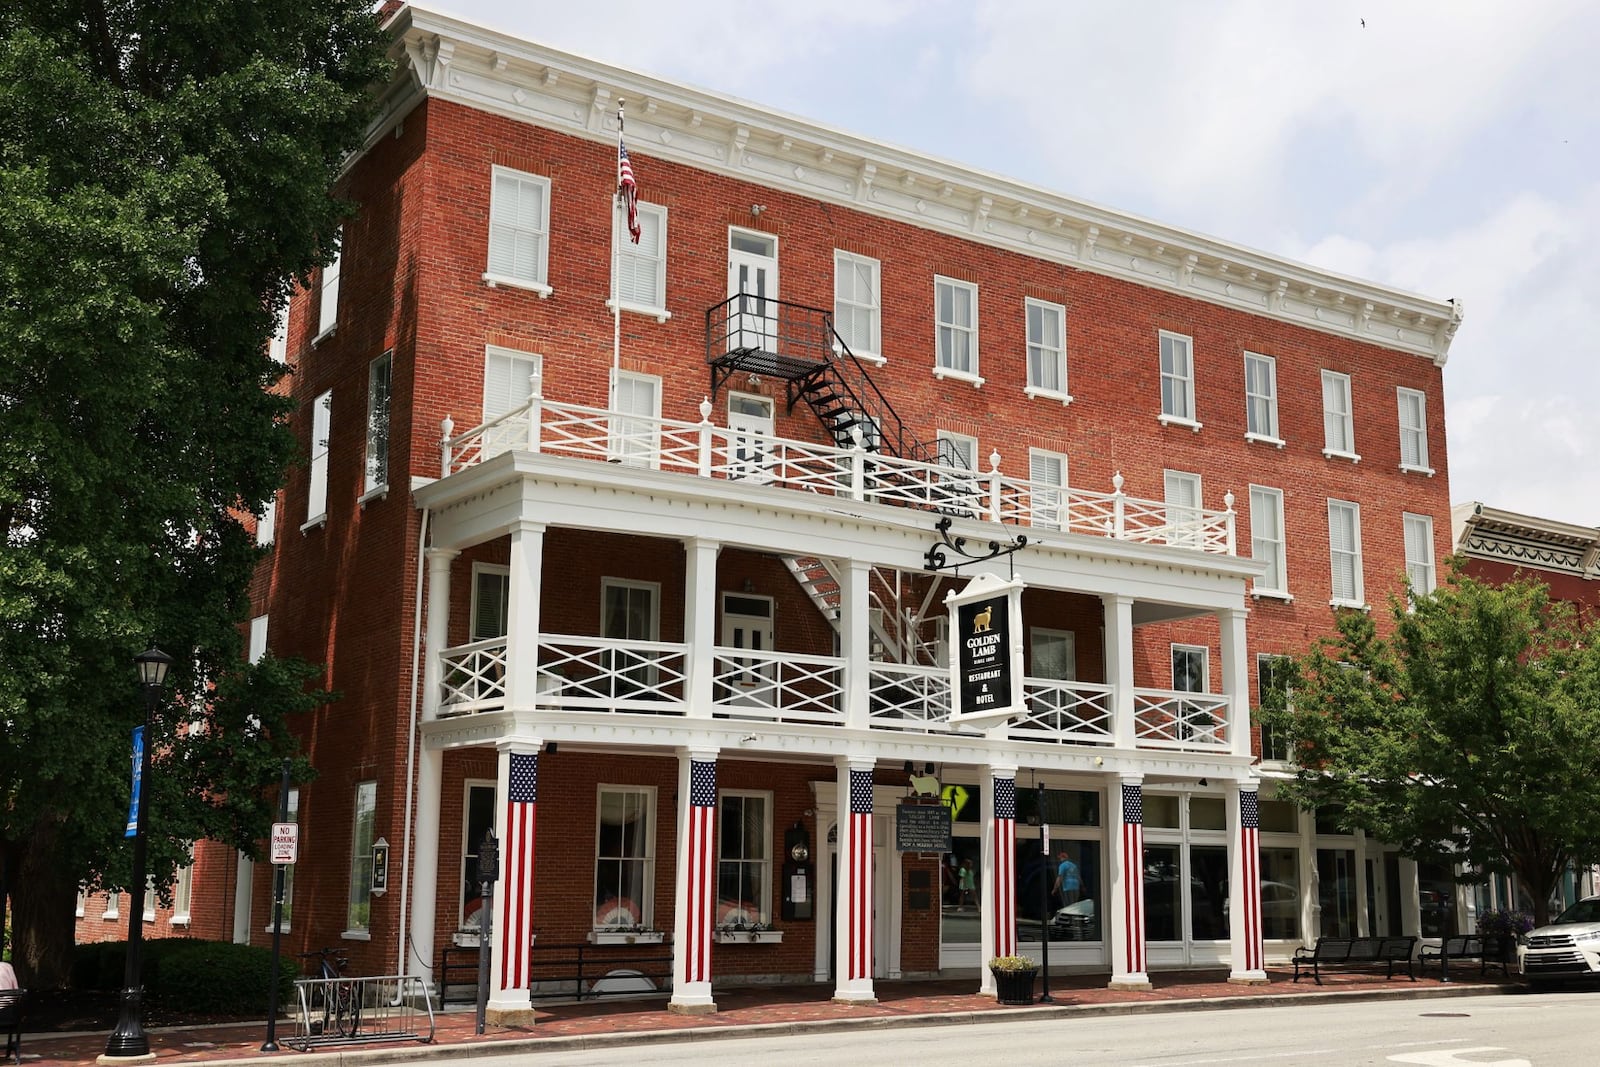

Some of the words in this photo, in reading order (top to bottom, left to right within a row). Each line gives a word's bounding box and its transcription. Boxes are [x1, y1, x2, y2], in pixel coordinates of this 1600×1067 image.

[967, 633, 1000, 648] GOLDEN
[972, 645, 996, 657] LAMB
[969, 670, 1001, 682] RESTAURANT
[982, 684, 988, 692] &
[976, 694, 994, 704] HOTEL
